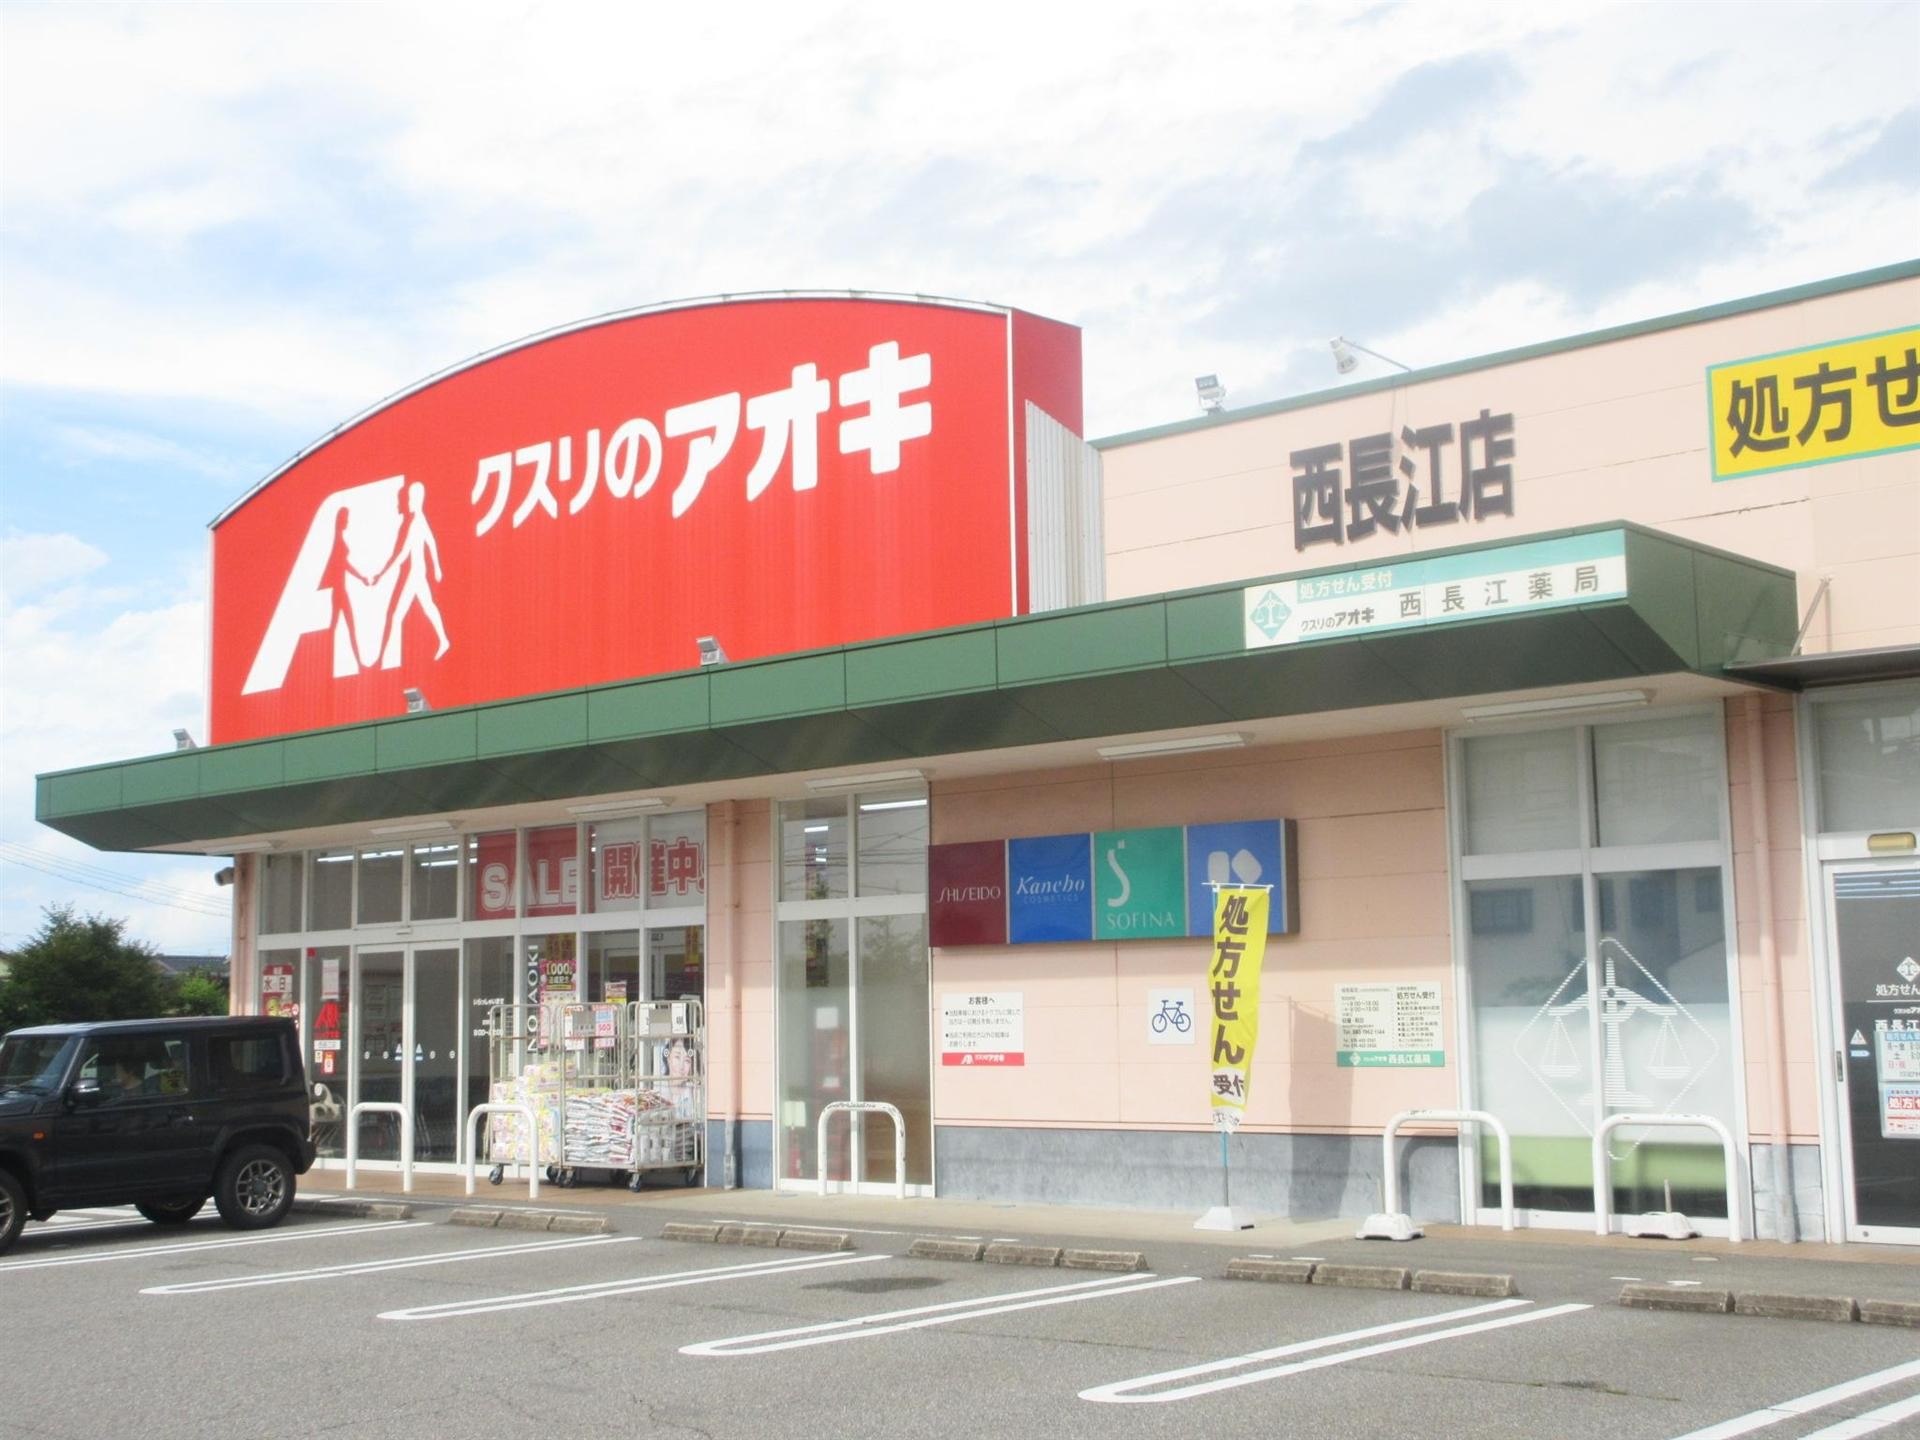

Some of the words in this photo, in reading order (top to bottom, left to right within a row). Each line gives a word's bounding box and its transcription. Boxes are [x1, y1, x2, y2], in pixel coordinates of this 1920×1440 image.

[471, 340, 933, 537] クスリのアオキ
[1289, 408, 1516, 552] 西長江店
[1300, 571, 1393, 599] 処方せん受付
[1300, 606, 1375, 633] クスリのアオキ
[1399, 565, 1599, 618] 西長江薬局
[481, 858, 577, 912] SALE
[602, 836, 704, 900] 開催中
[937, 886, 1001, 904] SHISEIDO
[1016, 874, 1085, 896] Kanebo
[1107, 911, 1175, 930] SOFINA
[1212, 894, 1249, 1065] 処方せん
